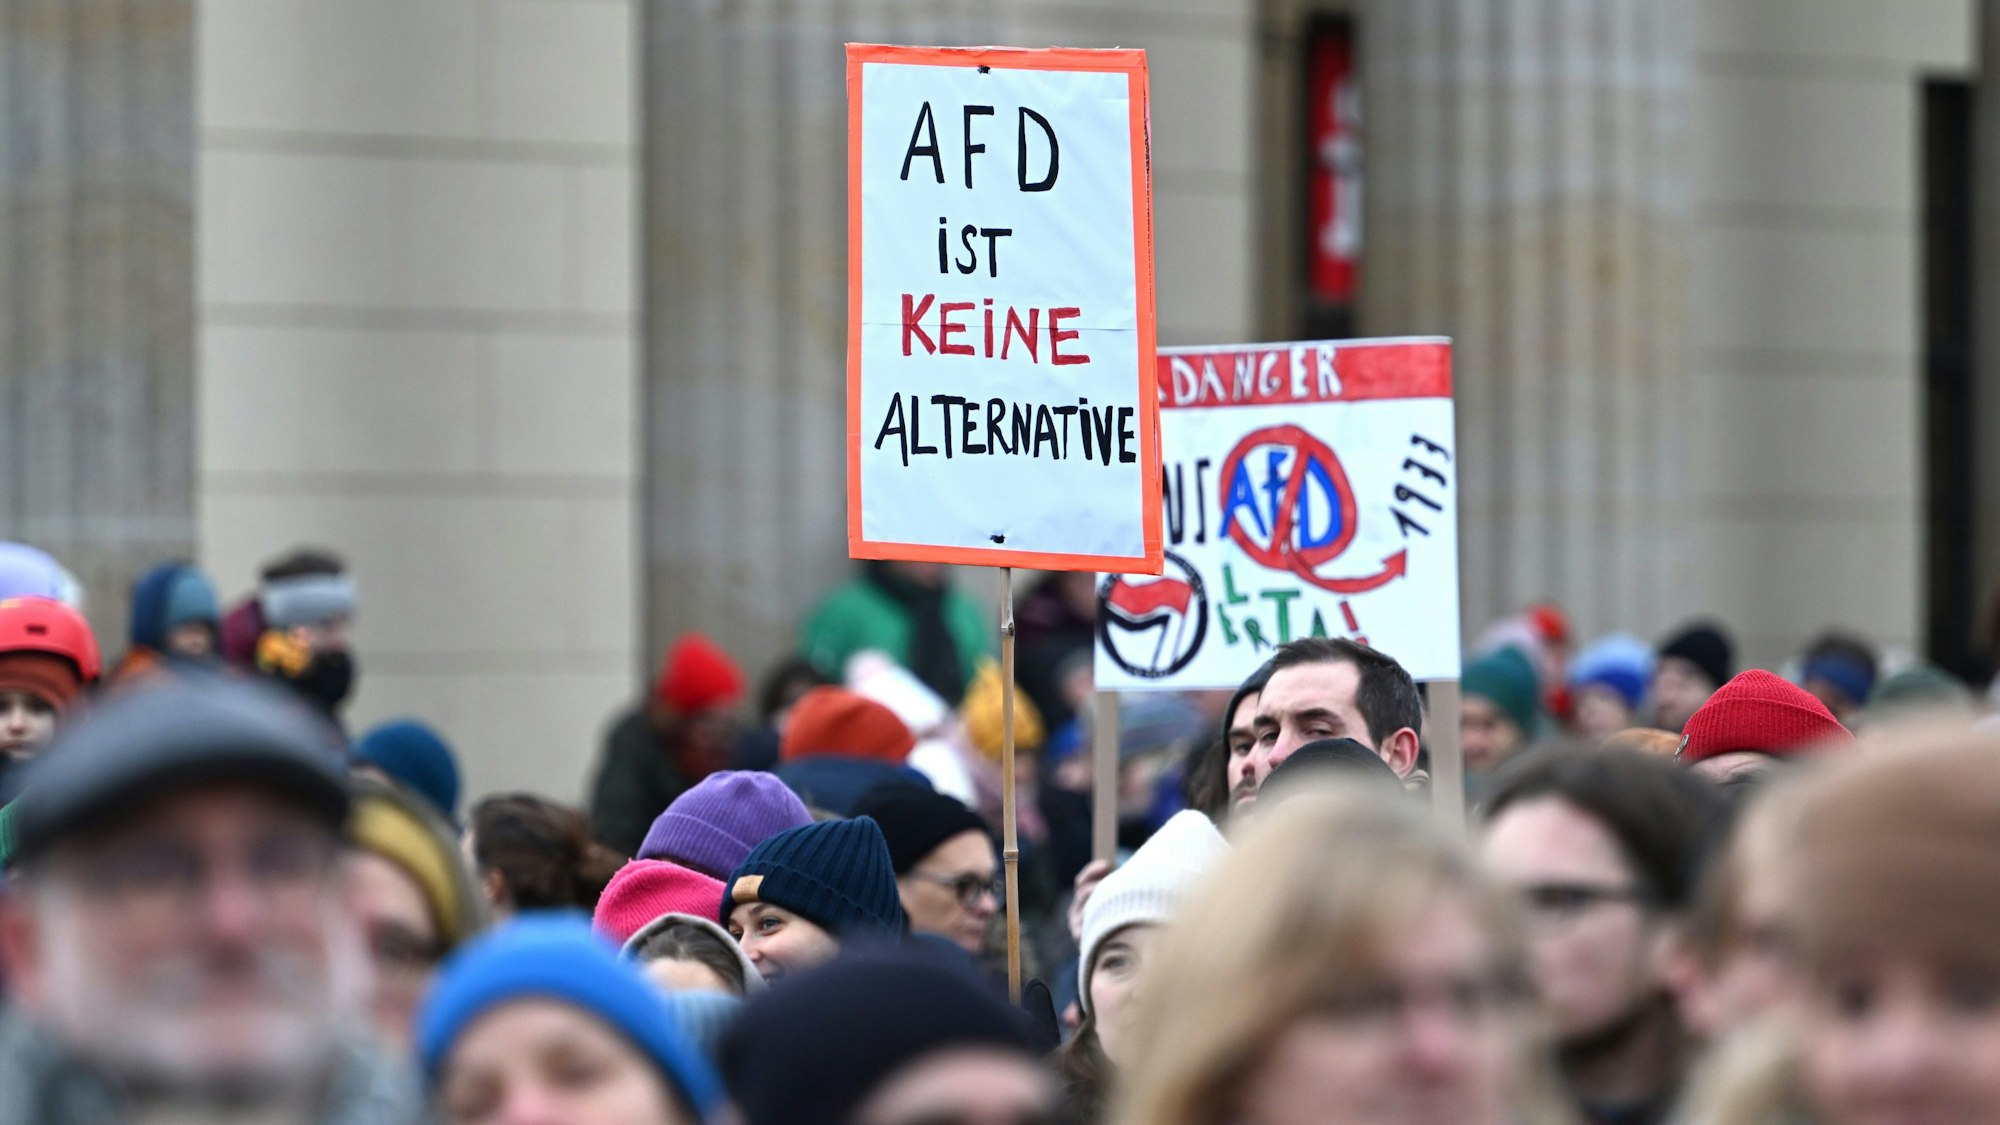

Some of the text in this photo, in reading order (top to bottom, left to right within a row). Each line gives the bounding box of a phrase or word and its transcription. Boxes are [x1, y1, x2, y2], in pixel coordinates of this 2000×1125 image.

[901, 101, 1059, 192] AFD
[1218, 451, 1343, 549] AFD
[1389, 434, 1451, 537] 1933
